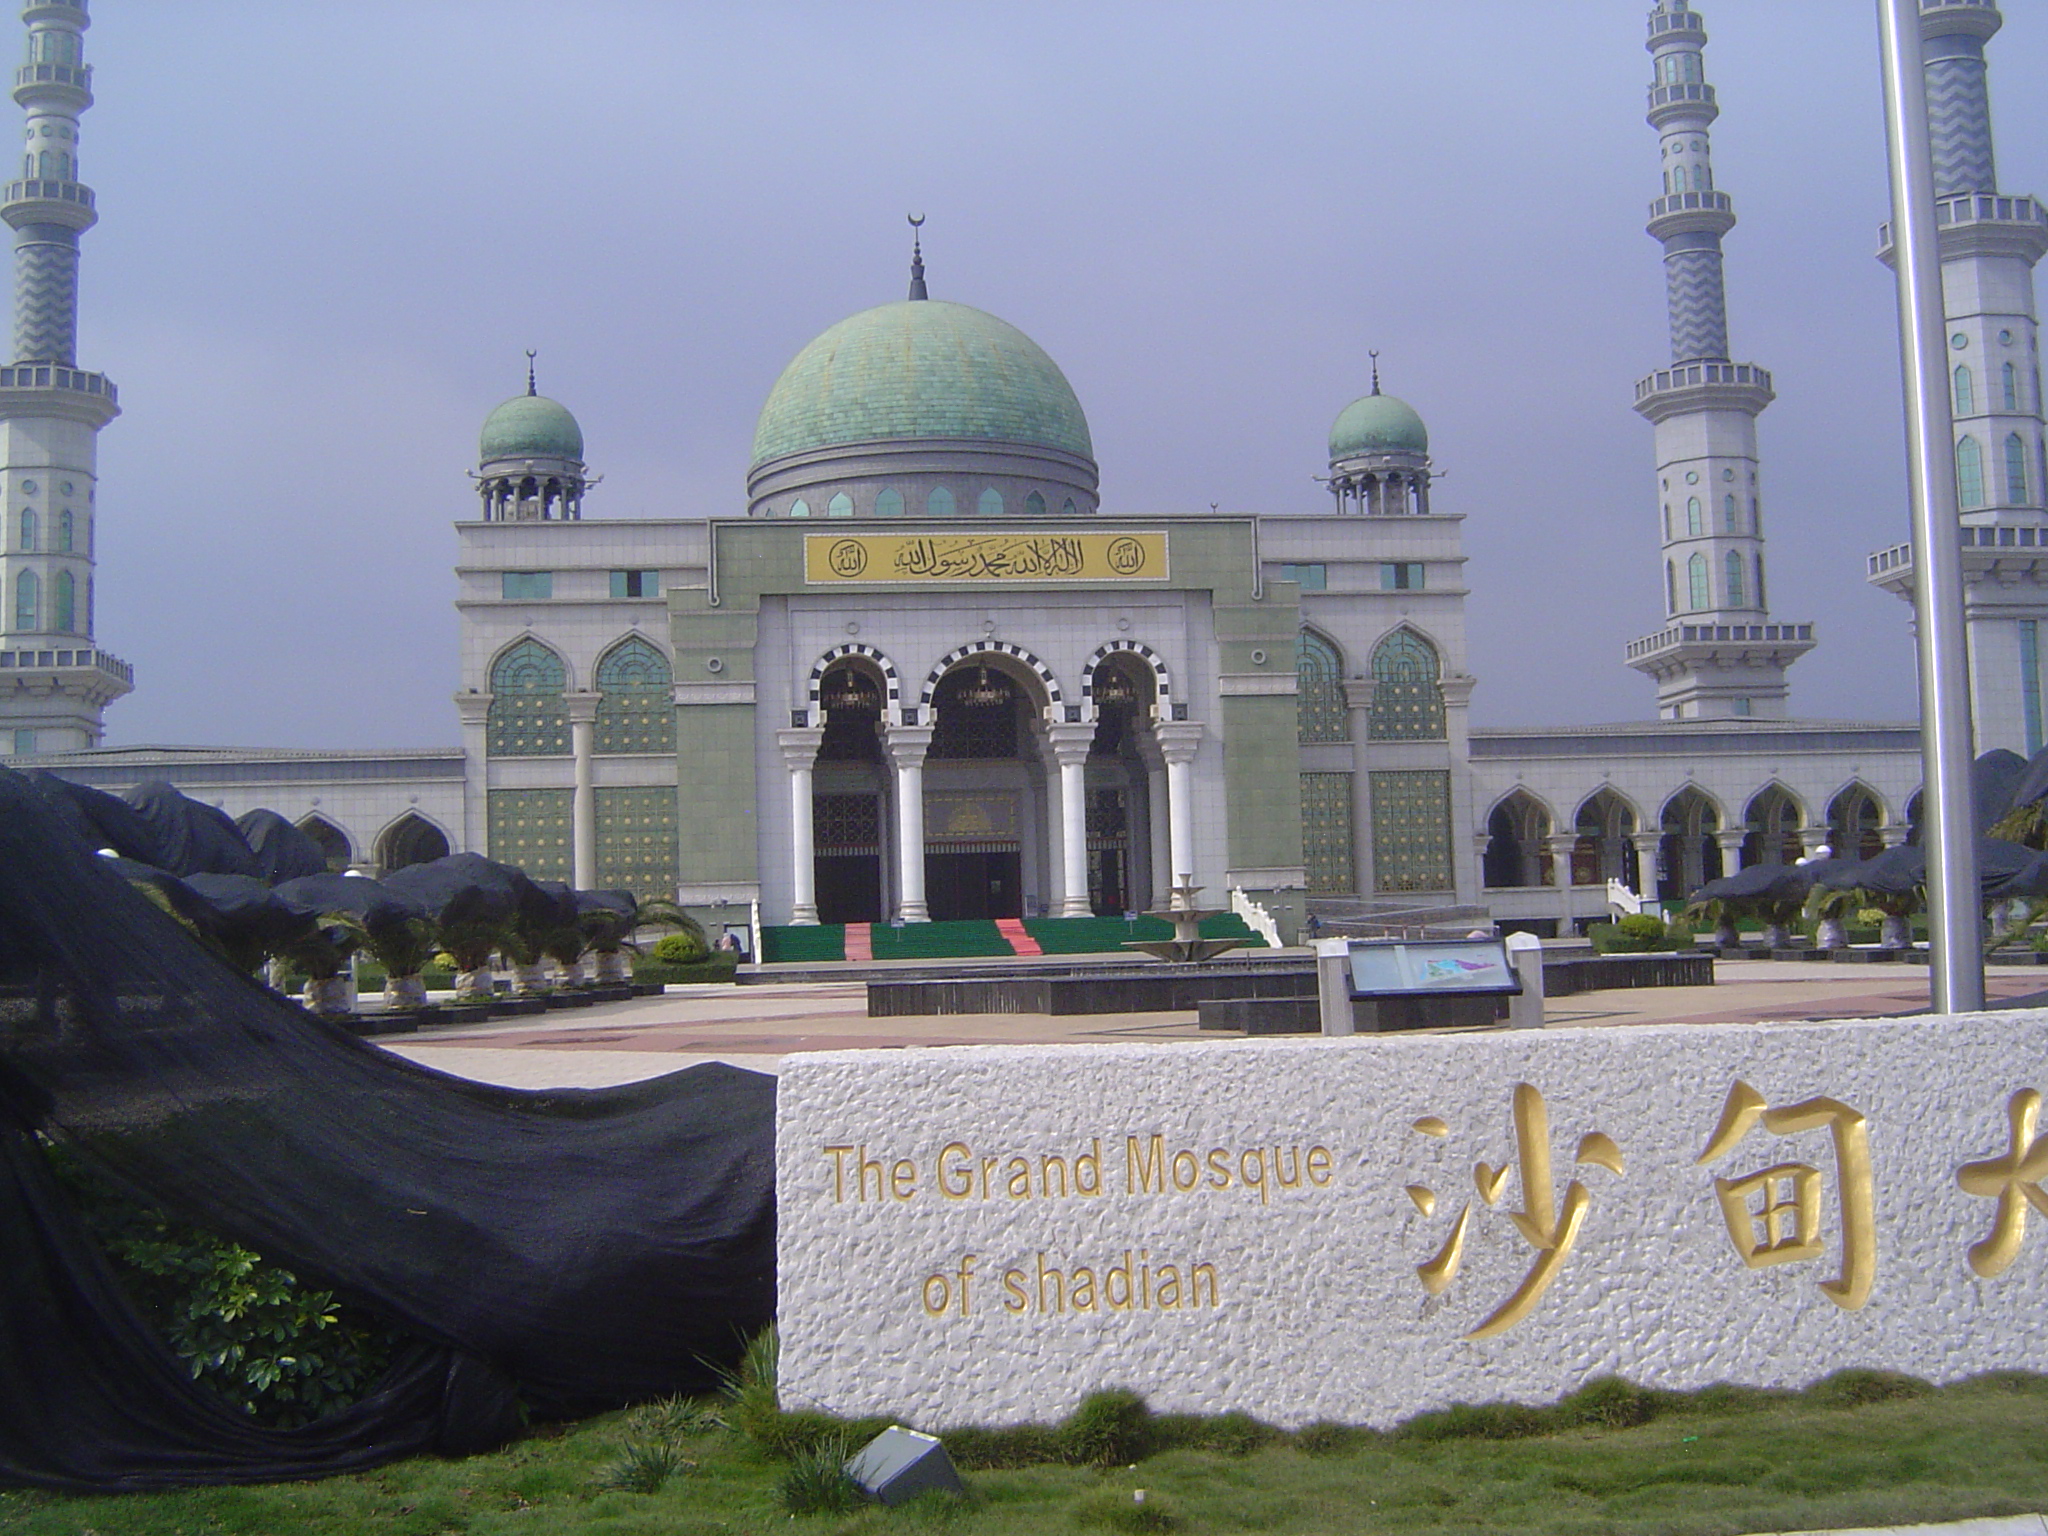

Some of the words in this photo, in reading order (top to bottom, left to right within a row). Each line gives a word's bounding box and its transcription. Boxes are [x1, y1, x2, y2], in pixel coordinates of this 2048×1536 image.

[823, 1144, 918, 1202] The
[937, 1138, 1102, 1200] Grand
[1126, 1133, 1334, 1204] Mosque
[922, 1254, 977, 1317] of
[1003, 1249, 1219, 1314] shadian
